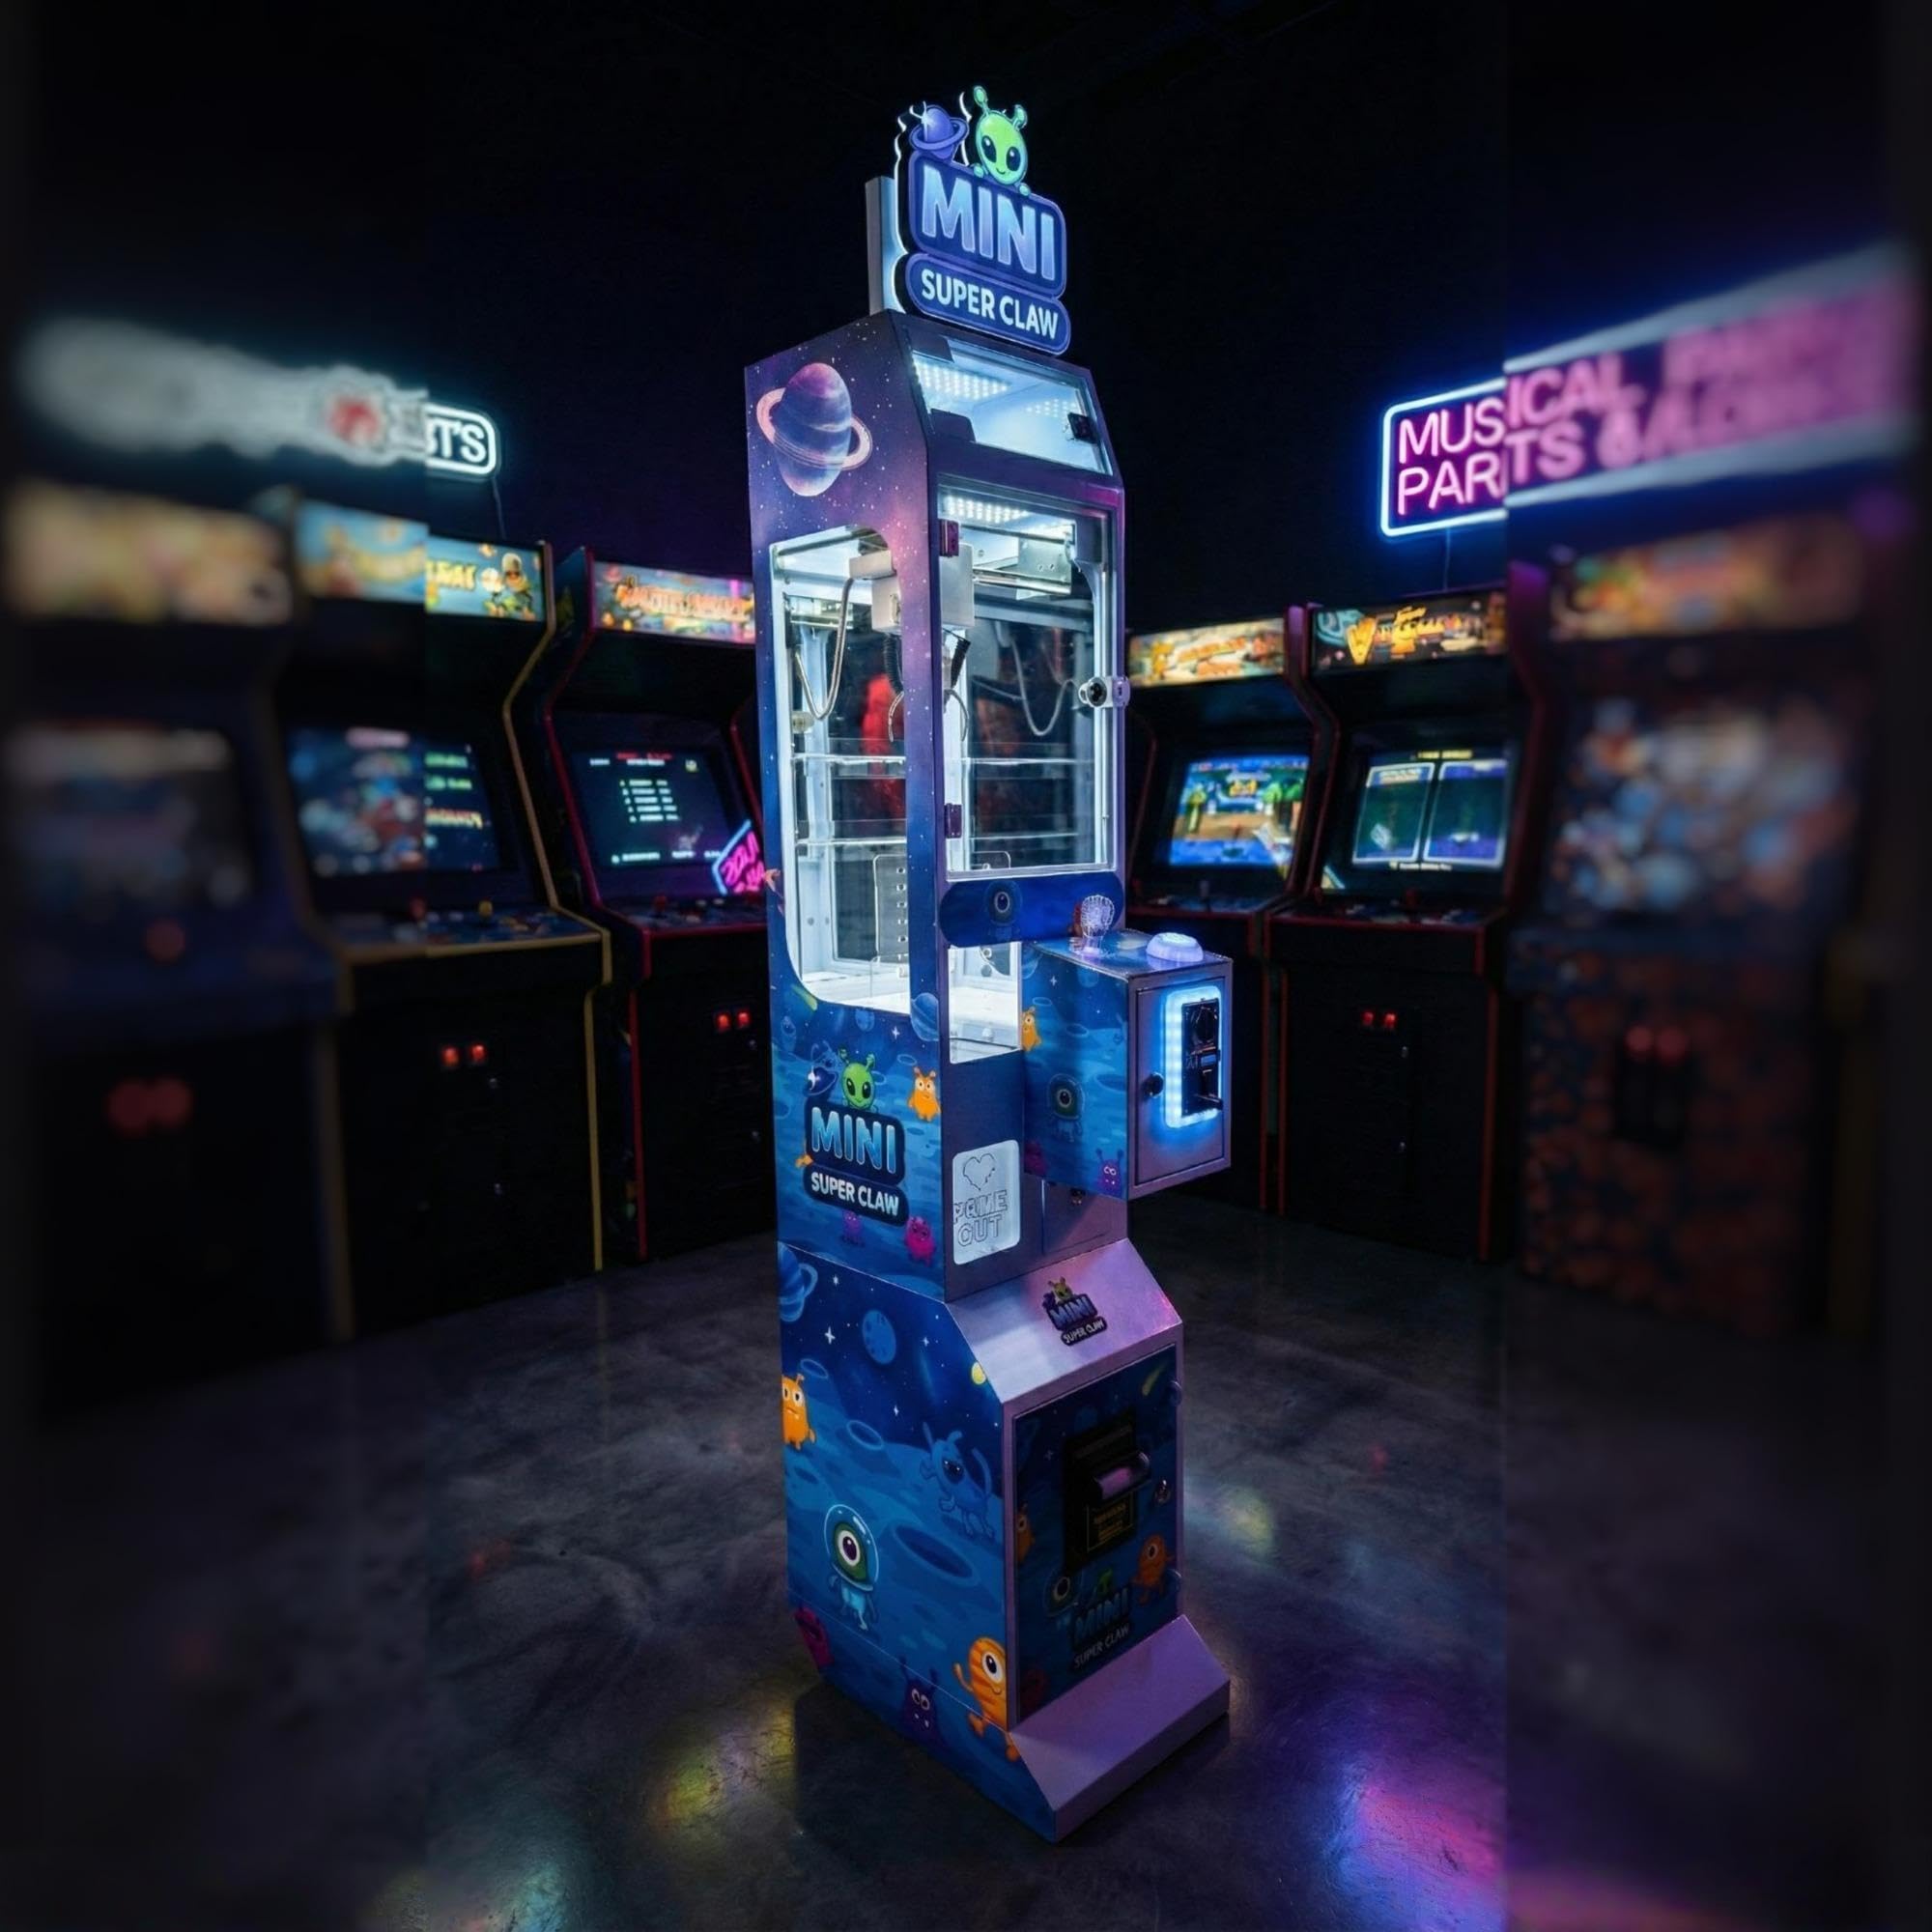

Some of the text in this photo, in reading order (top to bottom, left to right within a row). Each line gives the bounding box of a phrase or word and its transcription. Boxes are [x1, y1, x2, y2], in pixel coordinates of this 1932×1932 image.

[921, 163, 1055, 280] MINI
[920, 269, 1059, 339] SUPER CLAW
[811, 1106, 896, 1175] MINI
[810, 1172, 899, 1217] SUPER CLAW
[1049, 1296, 1096, 1328] MINI
[1073, 1623, 1130, 1669] SUPER CLAW
